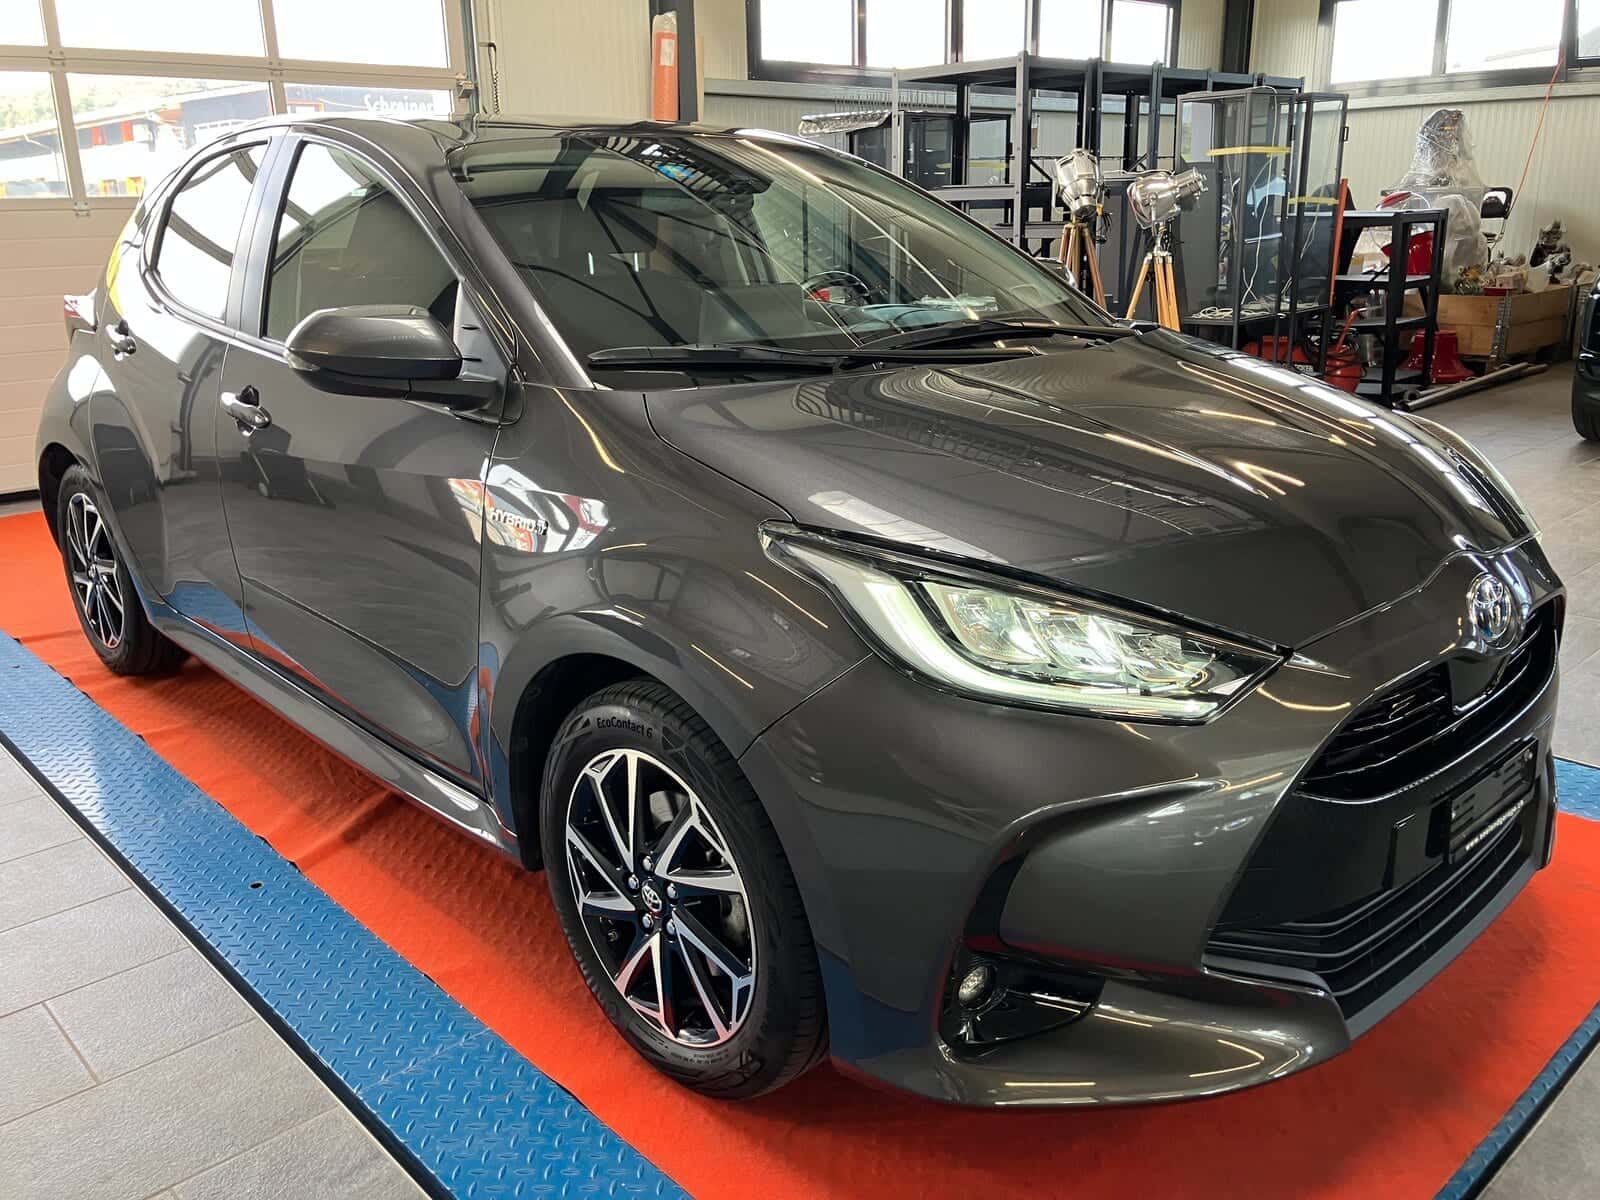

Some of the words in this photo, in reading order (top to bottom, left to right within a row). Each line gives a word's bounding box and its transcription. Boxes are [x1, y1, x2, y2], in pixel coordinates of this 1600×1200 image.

[490, 509, 536, 532] HYBRID
[597, 716, 644, 737] EcoContact
[646, 727, 653, 738] 6
